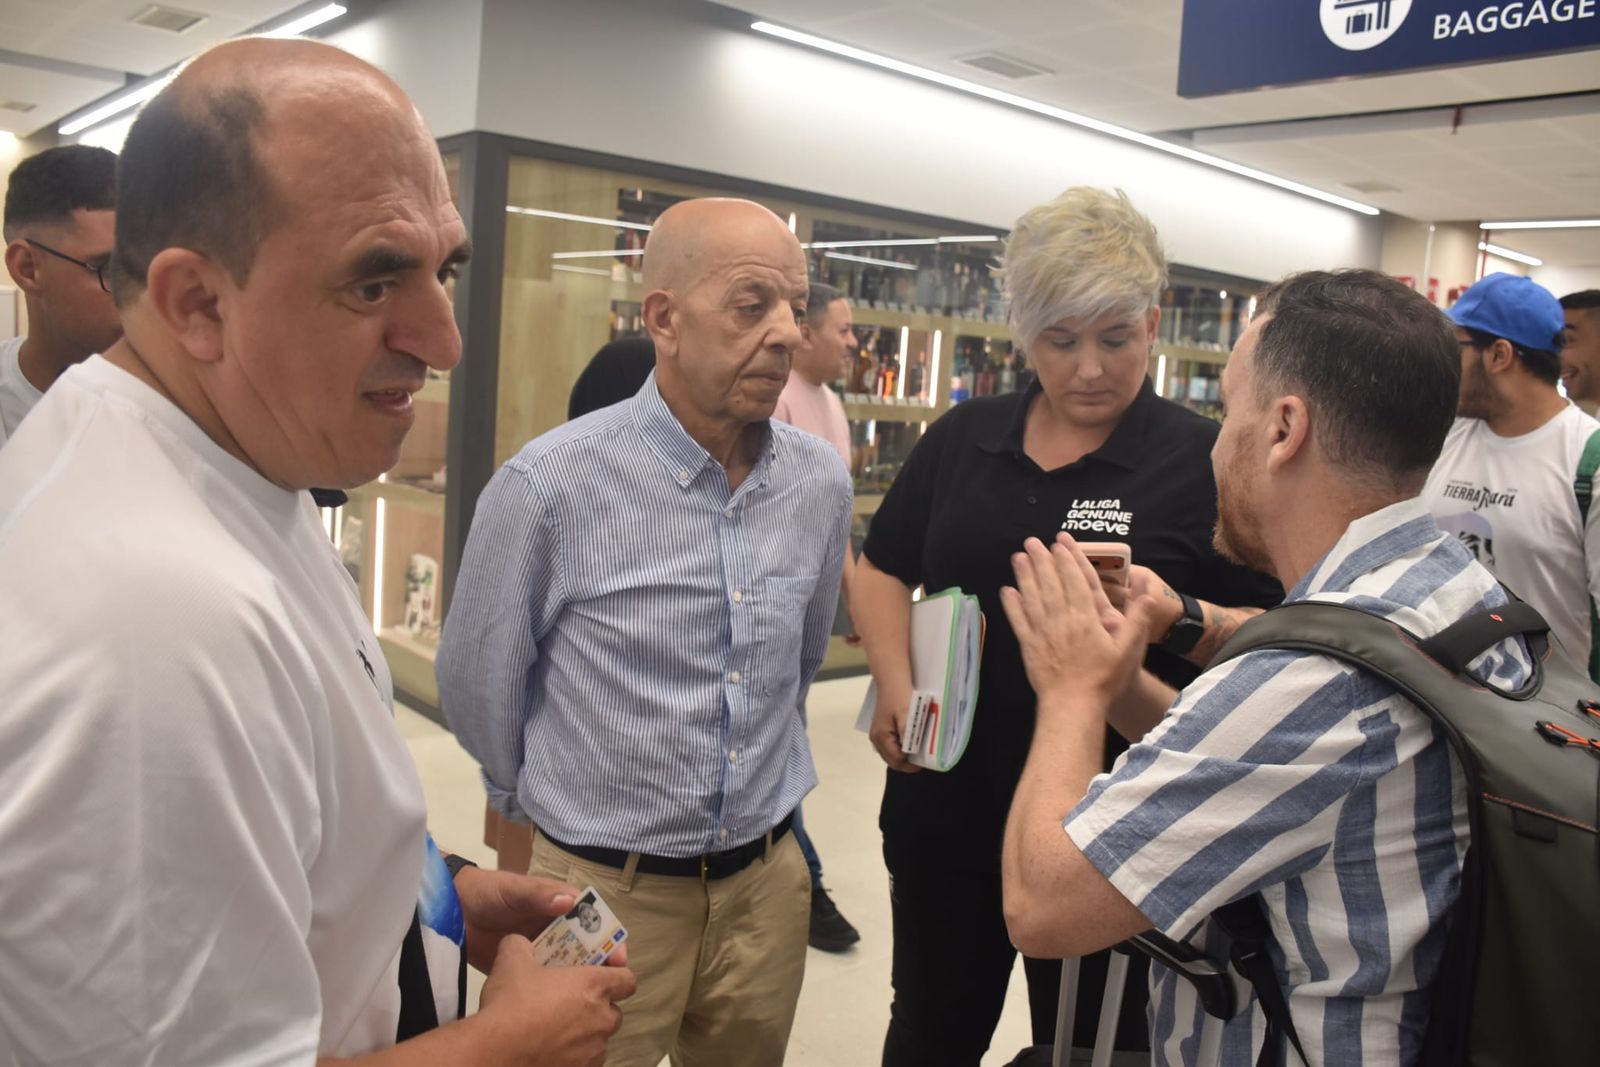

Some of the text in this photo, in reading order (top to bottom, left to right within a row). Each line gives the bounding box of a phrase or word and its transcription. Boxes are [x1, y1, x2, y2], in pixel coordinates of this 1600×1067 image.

[1433, 0, 1595, 39] BAGGAGE
[1443, 484, 1481, 502] TIERRA
[1072, 499, 1120, 509] LALIGA
[1066, 509, 1133, 523] GENUINE
[1061, 519, 1130, 535] moeve
